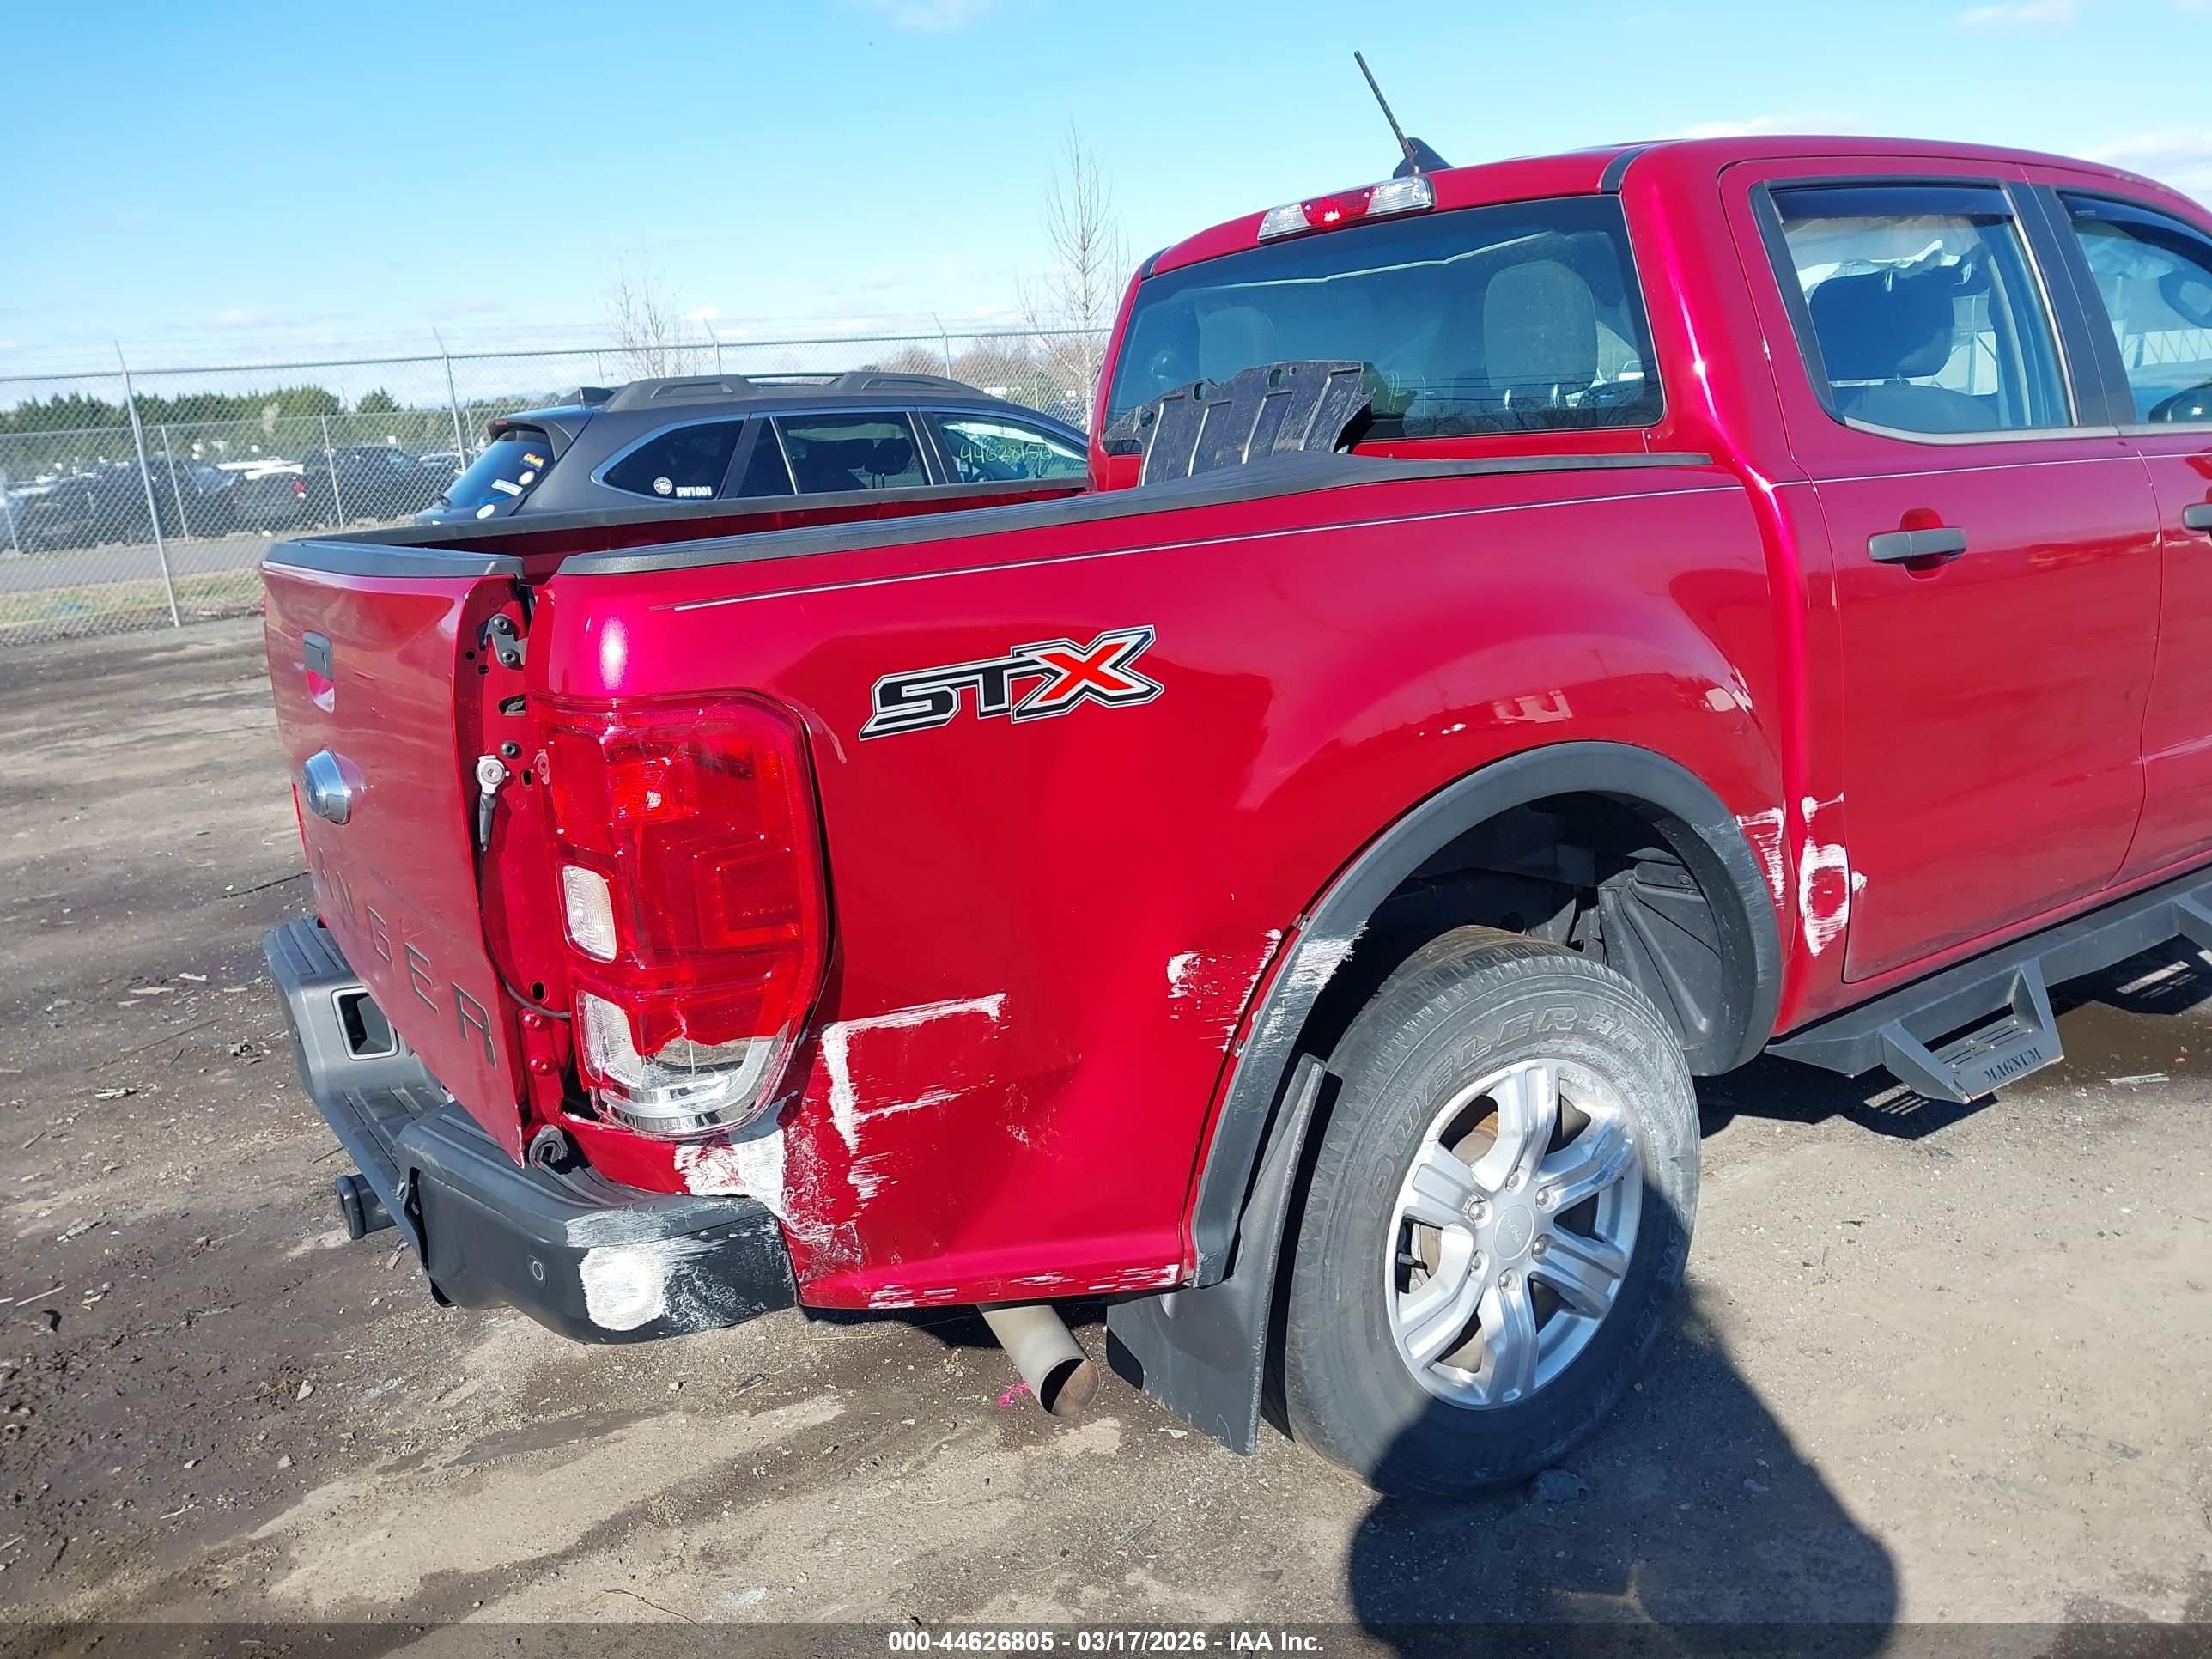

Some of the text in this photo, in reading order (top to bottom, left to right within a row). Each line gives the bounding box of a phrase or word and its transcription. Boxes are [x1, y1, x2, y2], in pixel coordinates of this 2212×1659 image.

[960, 443, 1053, 464] 44628150
[859, 624, 1164, 741] STX
[1983, 1047, 2043, 1085] MAGNUM
[1365, 1004, 1578, 1218] DUELER
